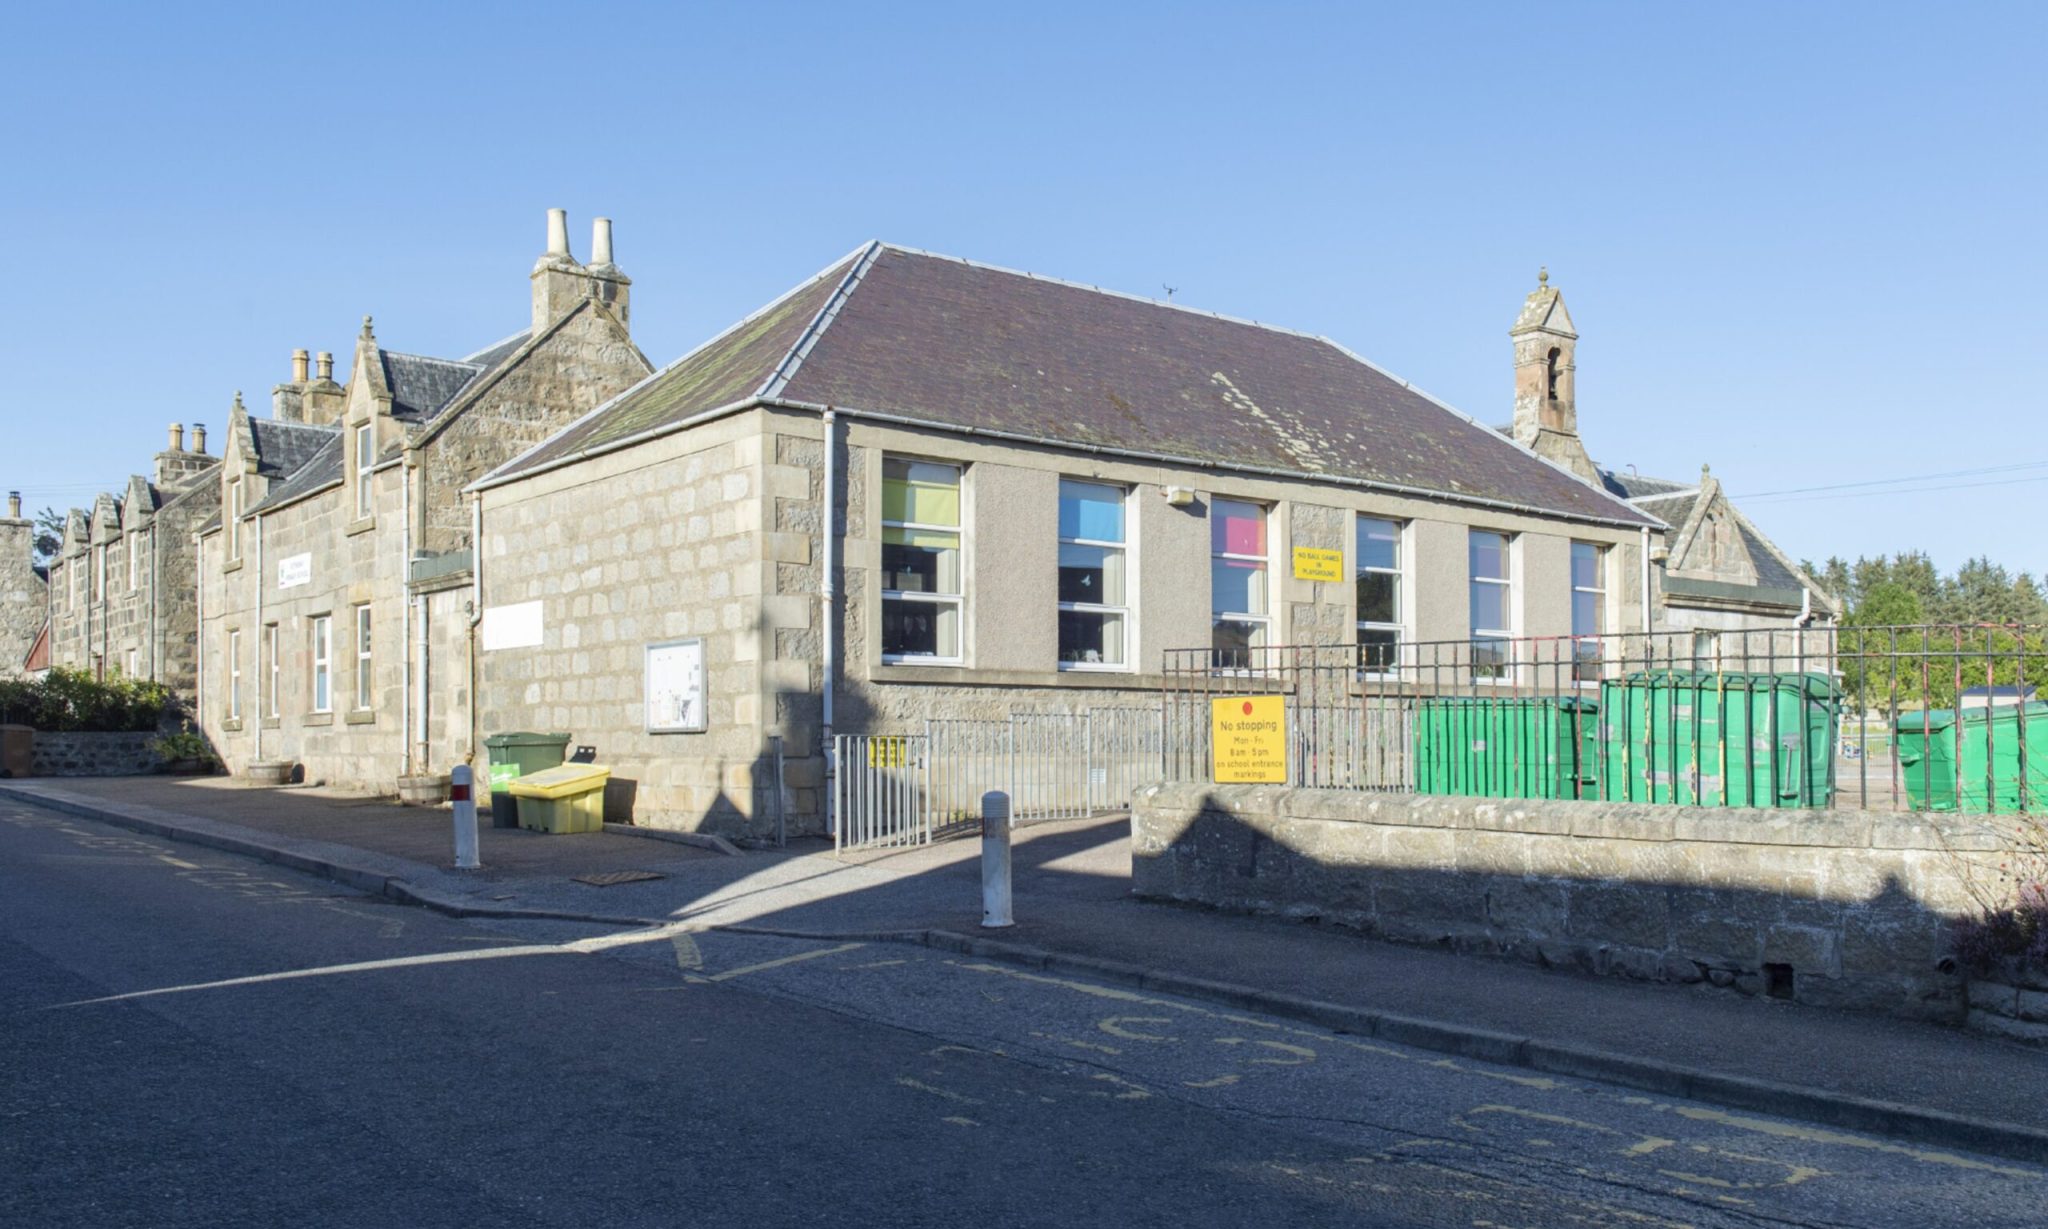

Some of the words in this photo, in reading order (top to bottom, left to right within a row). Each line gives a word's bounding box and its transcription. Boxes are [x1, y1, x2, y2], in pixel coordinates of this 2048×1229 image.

[1220, 721, 1233, 731] No
[1236, 719, 1277, 732] stopping
[1234, 736, 1248, 744] Mon
[1254, 735, 1264, 744] Fri
[1227, 760, 1250, 768] school
[1251, 760, 1283, 768] entrance
[1234, 771, 1266, 779] markings
